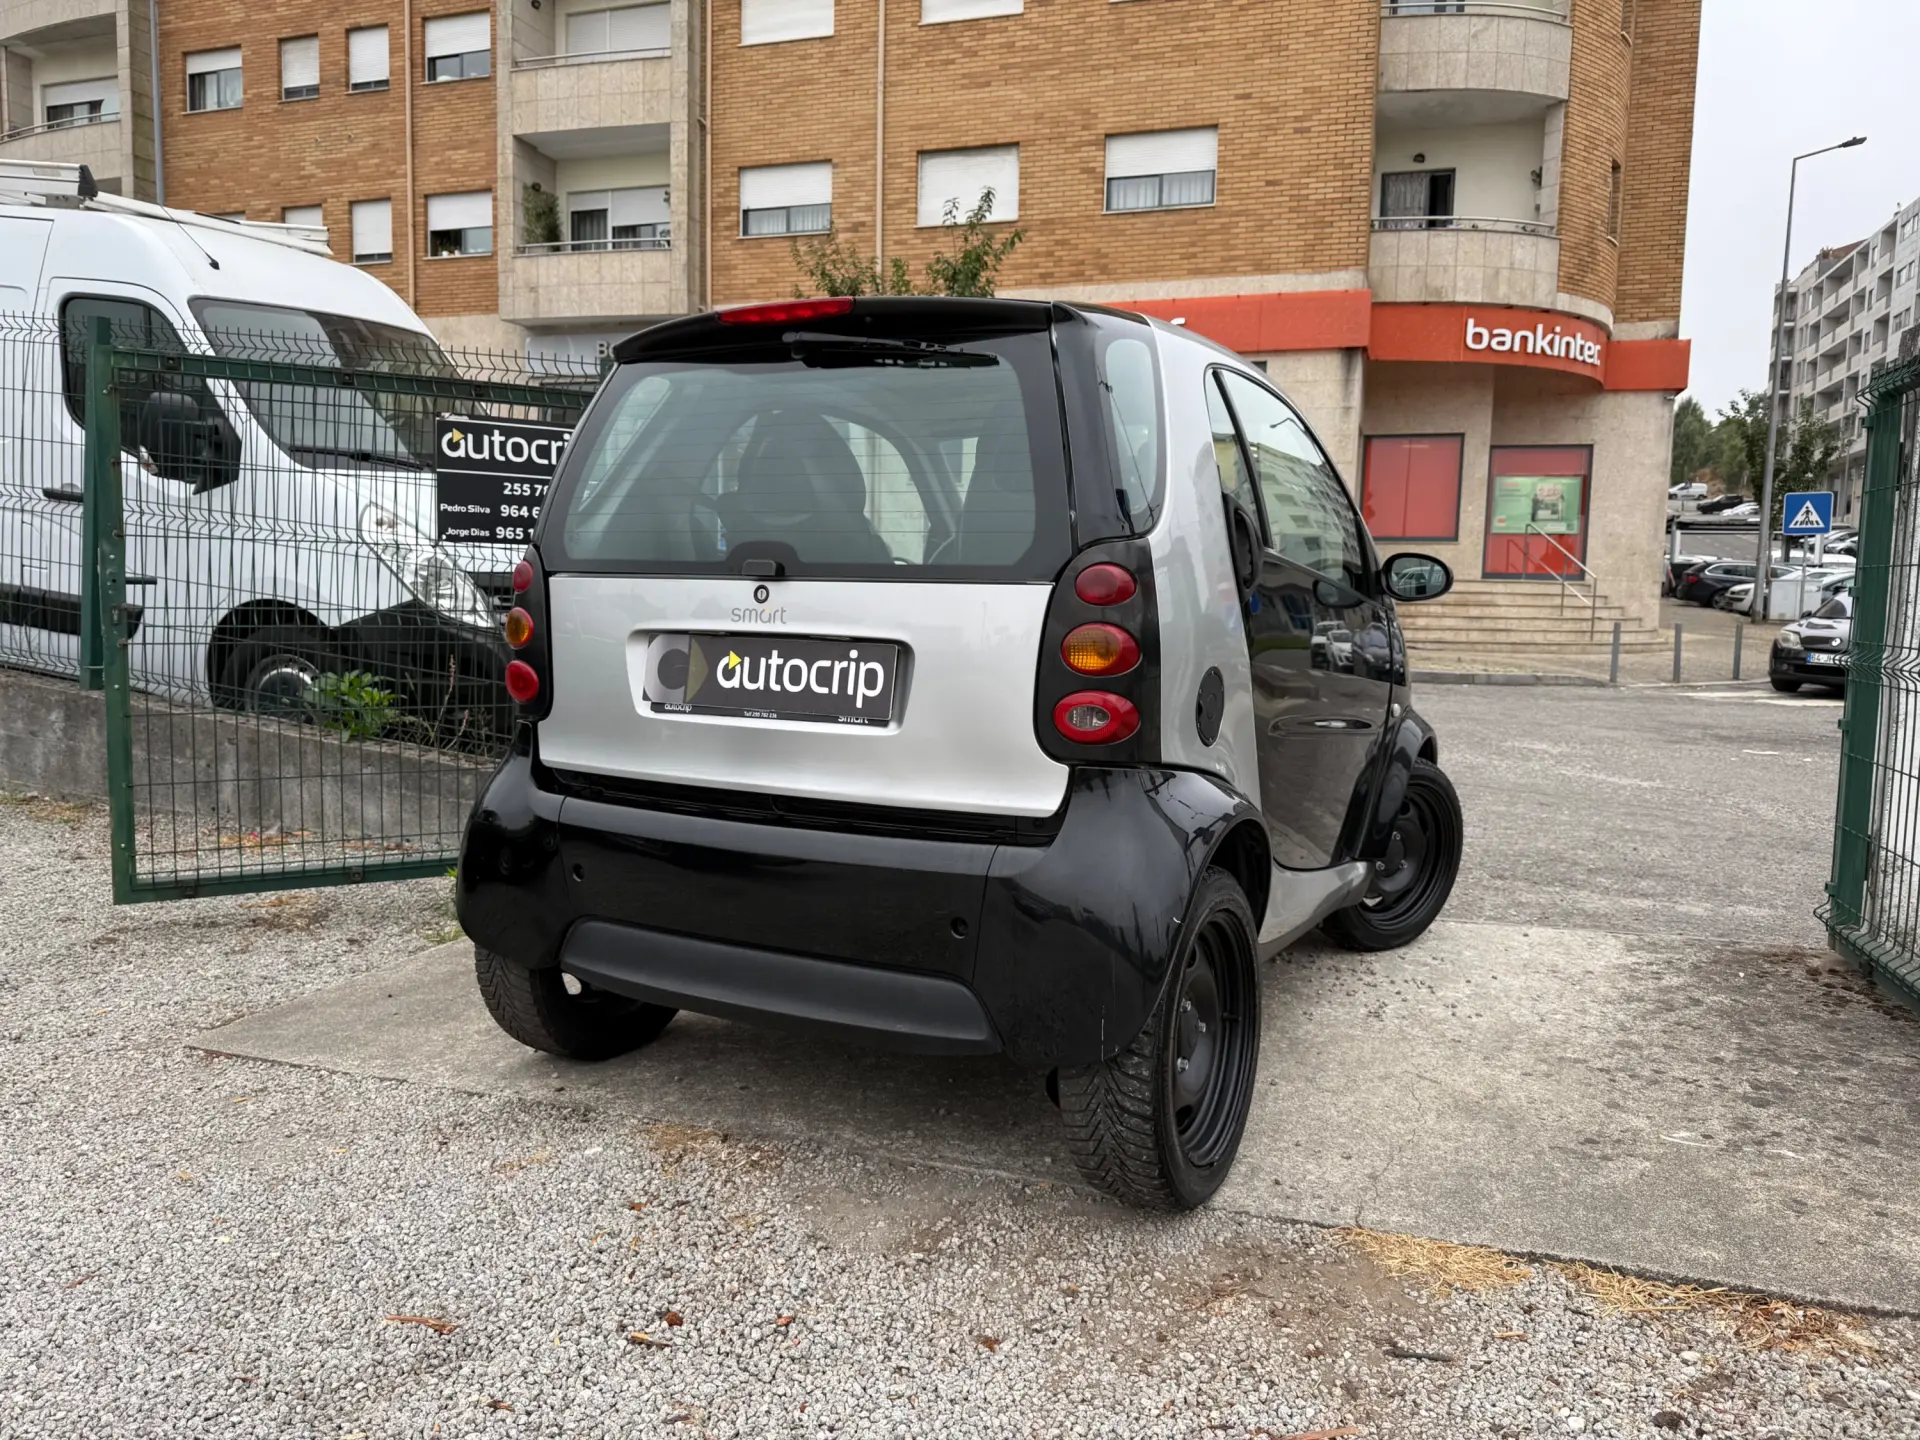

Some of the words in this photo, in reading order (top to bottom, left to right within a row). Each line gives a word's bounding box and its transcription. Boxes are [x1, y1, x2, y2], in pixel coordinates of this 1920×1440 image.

[503, 482, 531, 496] 255
[440, 503, 467, 513] Pedro
[467, 504, 491, 514] Silva
[500, 504, 529, 518] 964
[445, 527, 470, 538] Jorge
[470, 527, 490, 537] Dias
[495, 526, 524, 540] 965
[730, 606, 787, 625] smart
[716, 648, 885, 709] autocrip
